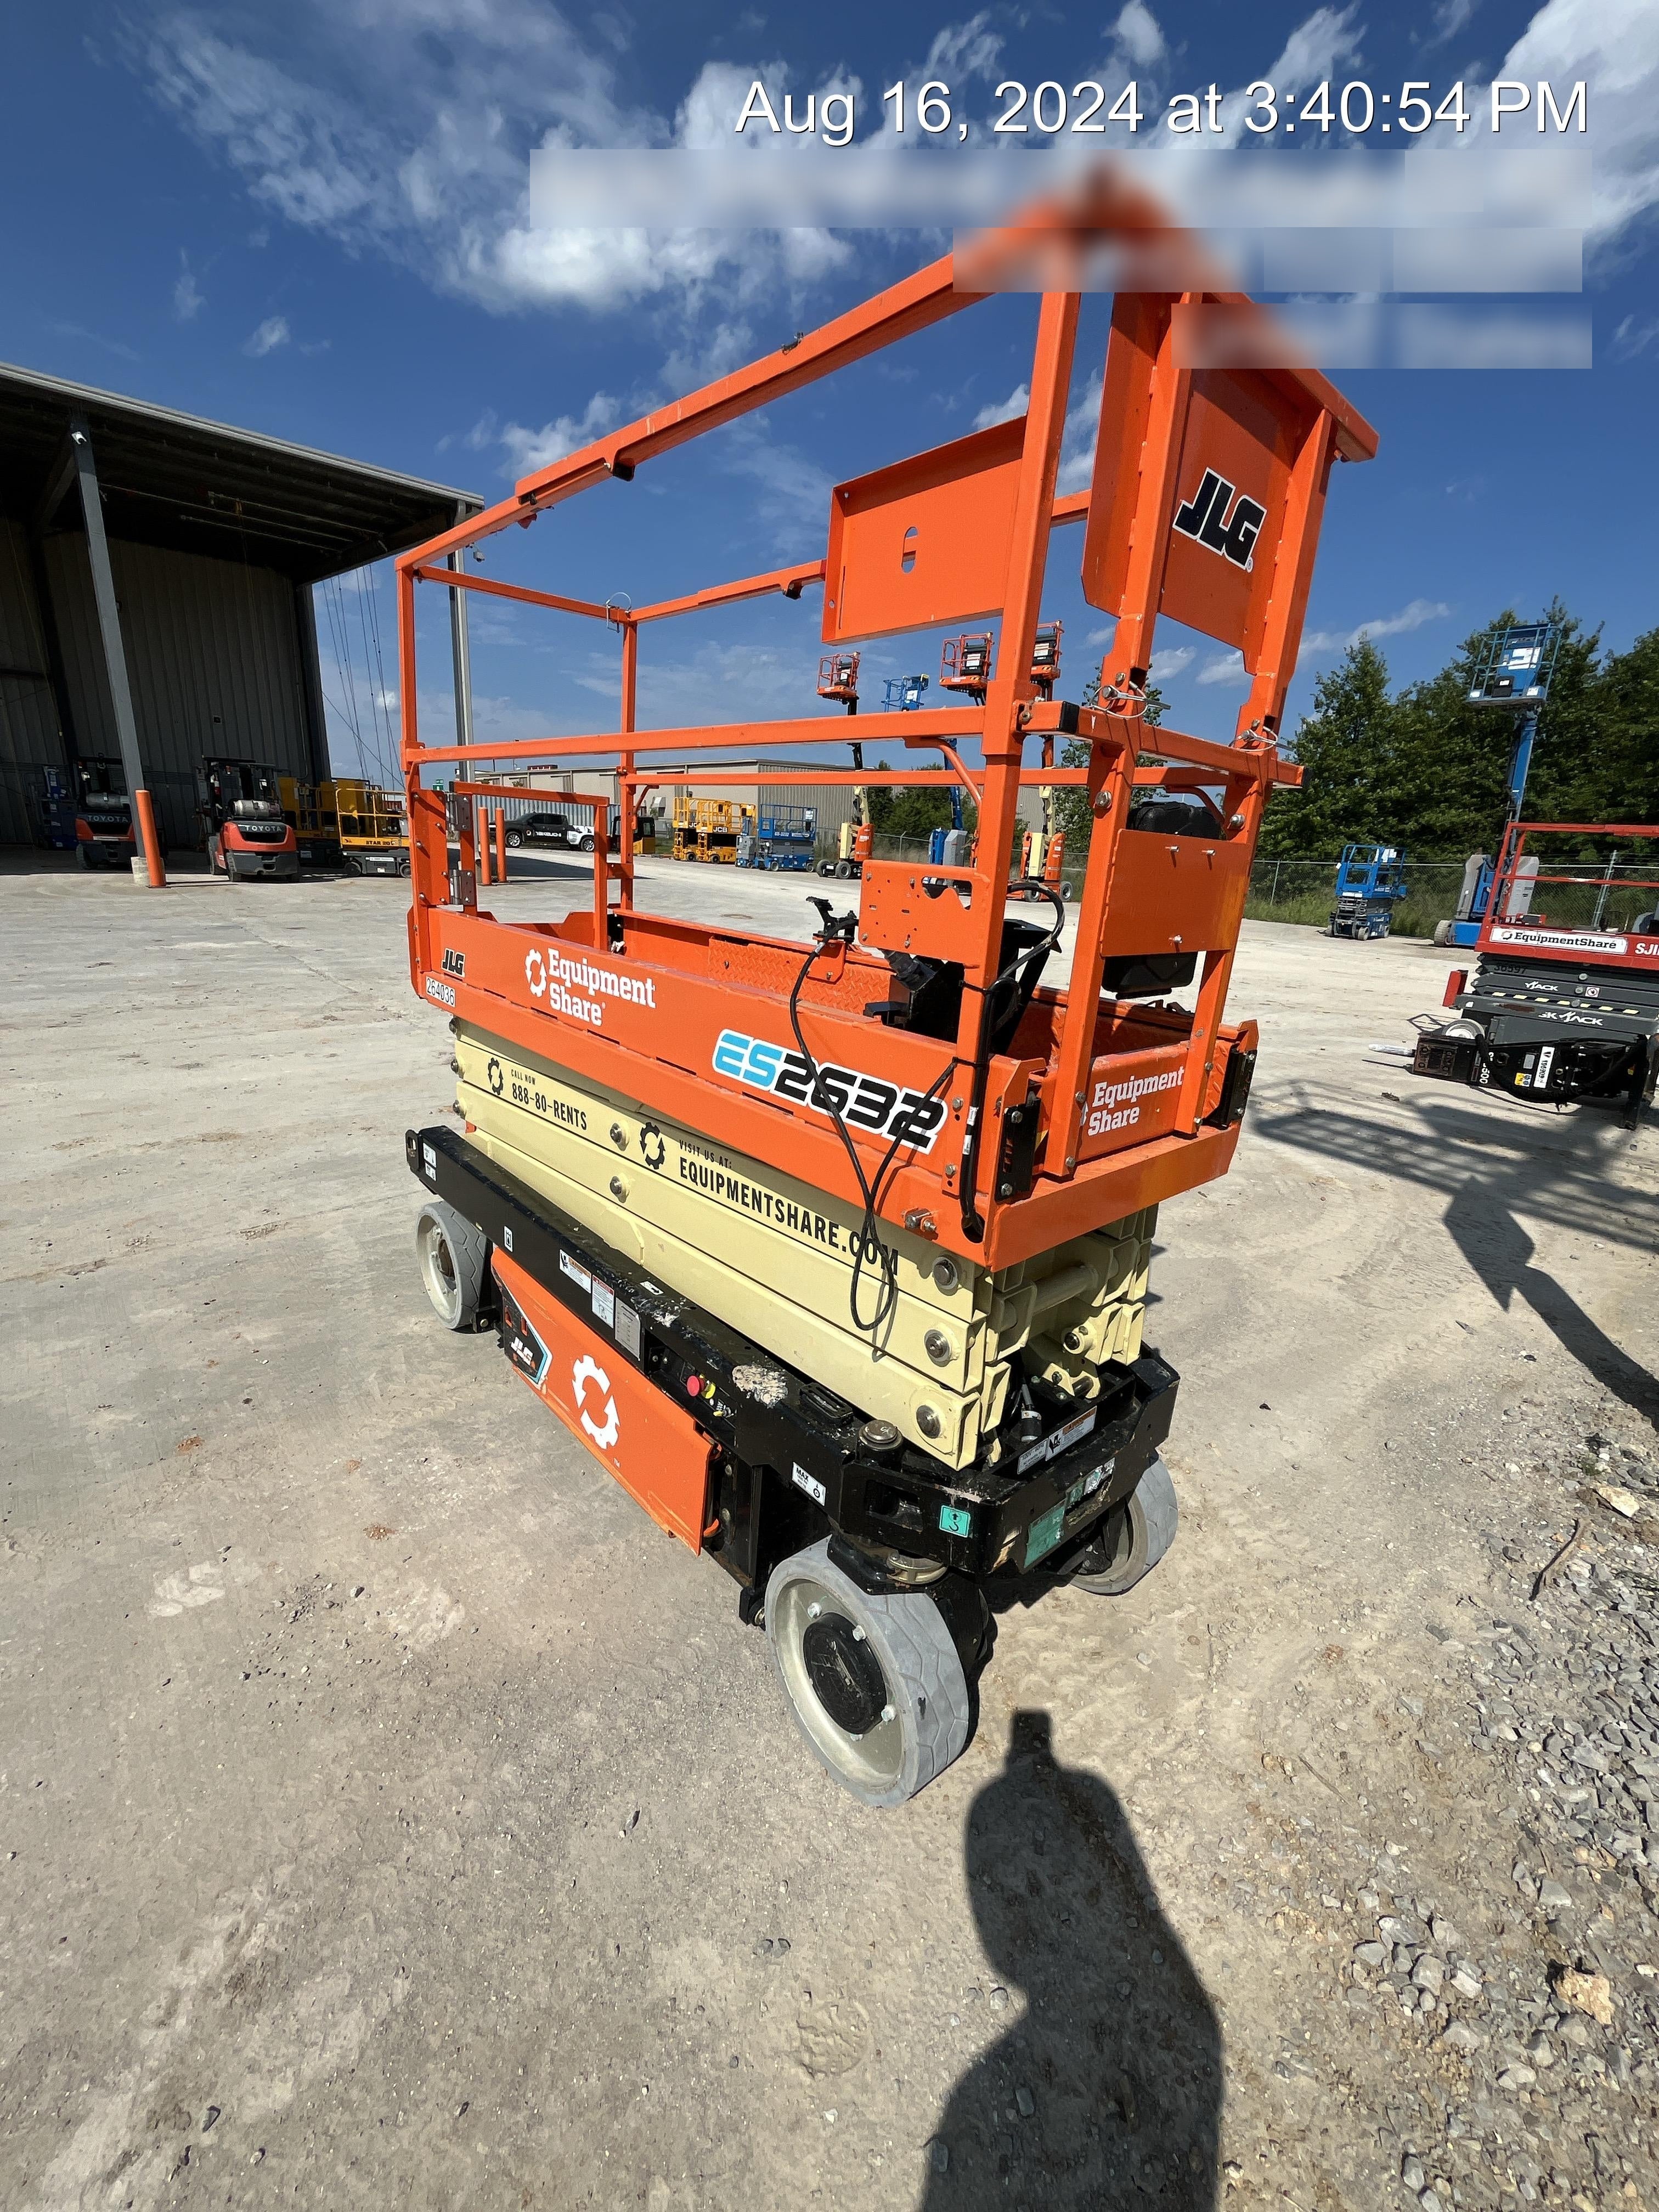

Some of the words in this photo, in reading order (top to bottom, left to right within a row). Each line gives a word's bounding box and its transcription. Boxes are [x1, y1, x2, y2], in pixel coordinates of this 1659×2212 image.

[1172, 467, 1267, 569] JLG
[1514, 932, 1617, 949] EquipmentShare
[441, 948, 465, 977] JLG
[427, 978, 455, 1006] 264036
[548, 948, 656, 1008] Equipment
[549, 982, 602, 1026] Share
[511, 1069, 523, 1081] CALL
[524, 1075, 536, 1086] NOW
[713, 1031, 946, 1152] ES2632
[1092, 1066, 1184, 1107] Equipment
[512, 1082, 587, 1131] 888-80-RENTS
[1088, 1106, 1140, 1136] Share
[679, 1139, 700, 1156] VISIT
[704, 1150, 715, 1162] US
[719, 1155, 732, 1169] AT:
[679, 1156, 899, 1276] EQUIPMENTSHARE.COM
[510, 1336, 533, 1366] JLG
[796, 1467, 809, 1482] MAX
